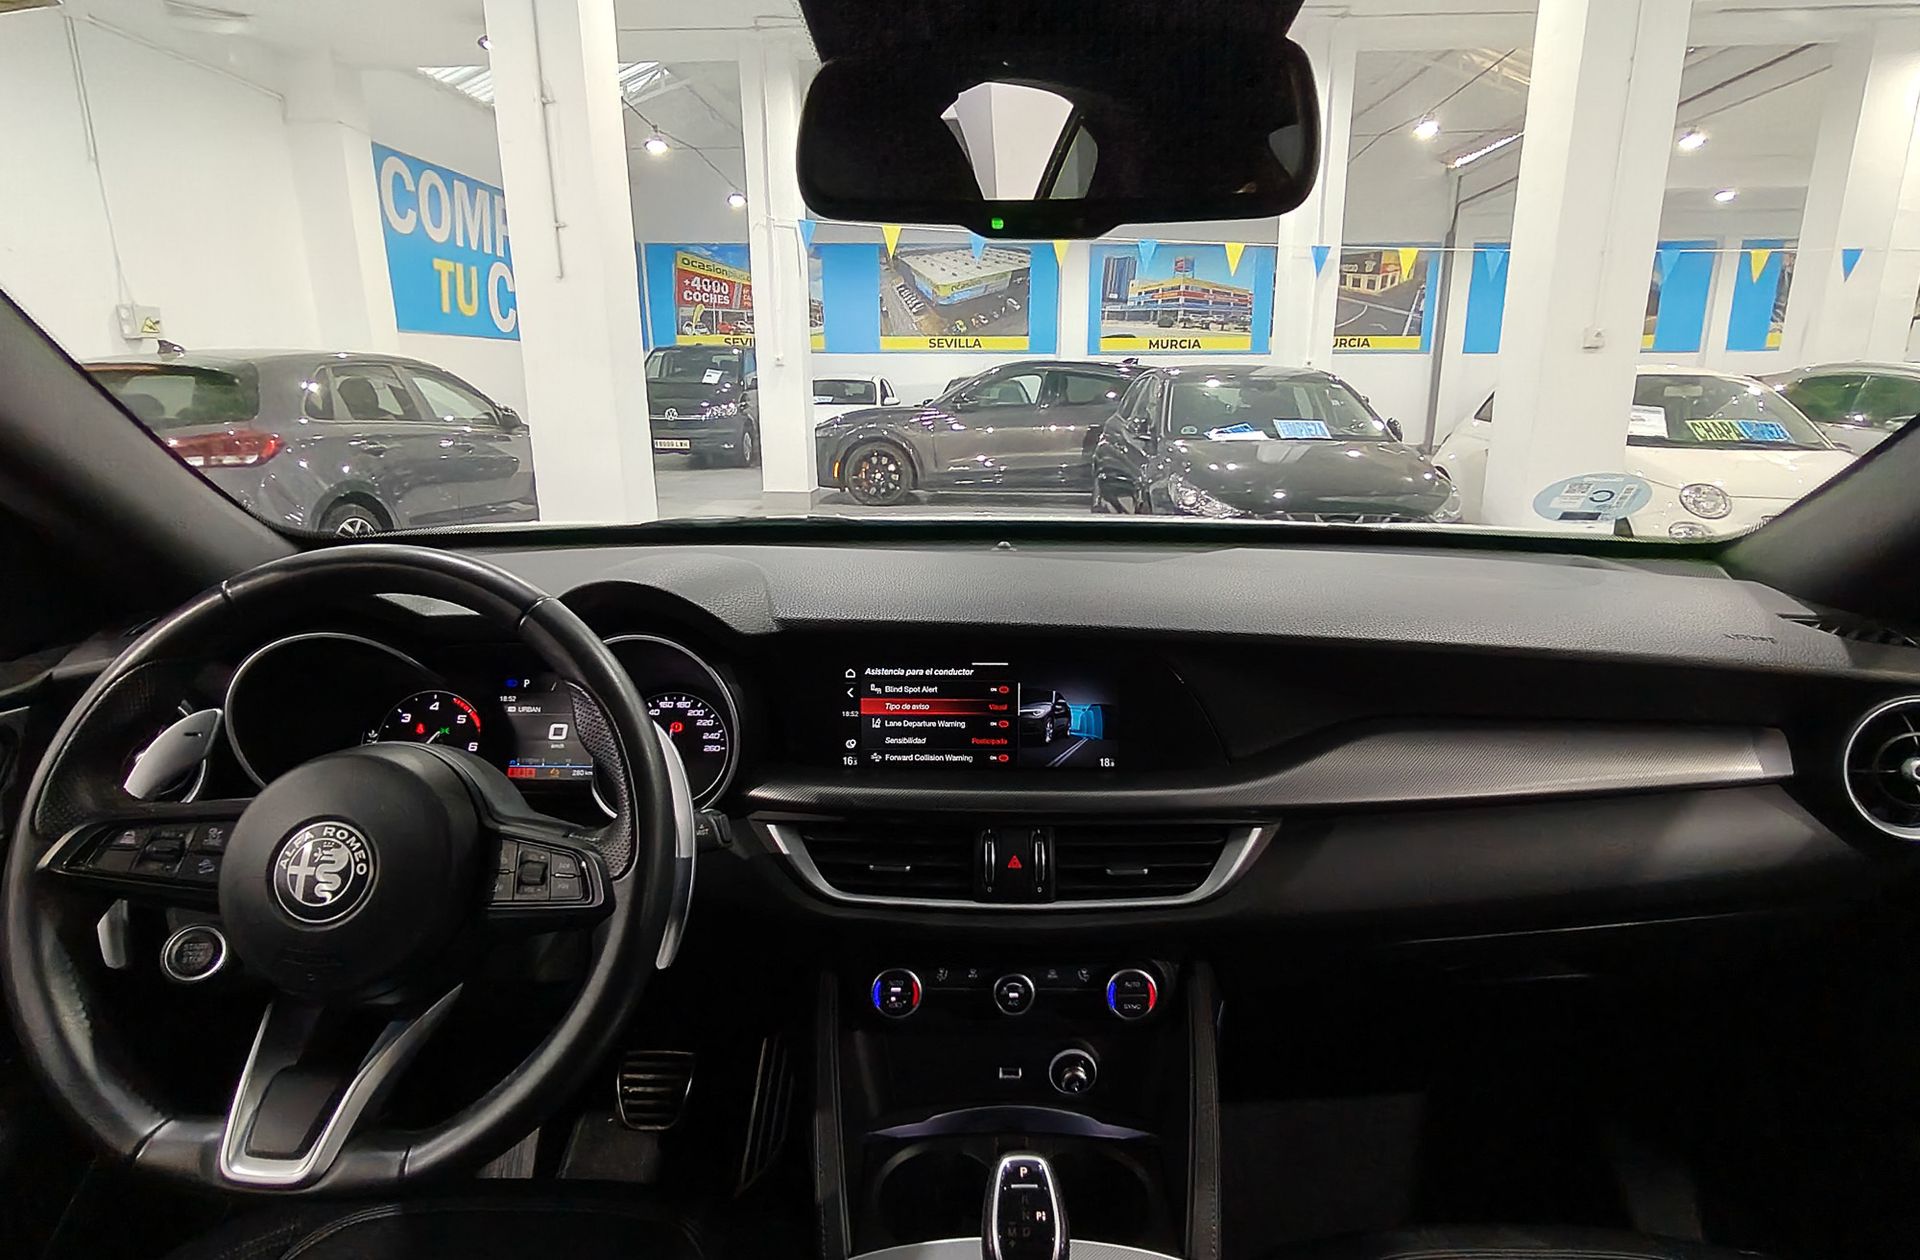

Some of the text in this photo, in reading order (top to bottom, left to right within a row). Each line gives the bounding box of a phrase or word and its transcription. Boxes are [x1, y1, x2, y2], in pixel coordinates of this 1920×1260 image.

[433, 257, 478, 317] TU
[683, 290, 730, 305] COCHES
[928, 338, 982, 349] SEVILLA
[1149, 339, 1201, 349] MURCIA
[1690, 421, 1743, 441] CHAPA
[864, 668, 975, 677] Asistencia para el conductor
[524, 679, 530, 688] P
[884, 685, 939, 694] Blind Spot Alert
[499, 695, 517, 703] 18:52
[429, 701, 440, 711] 4
[885, 703, 901, 711] Tipo
[401, 713, 412, 723] 3
[456, 714, 467, 724] 5
[841, 710, 859, 718] 18:52
[884, 720, 966, 729] Lane Departure Warning
[548, 723, 569, 740] 0
[702, 732, 720, 740] 240
[884, 737, 927, 745] Sensibilidad
[468, 742, 478, 752] 6
[885, 754, 974, 763] Forward Collision Warning
[279, 826, 368, 875] ALFA ROMEO
[1019, 1166, 1028, 1178] P
